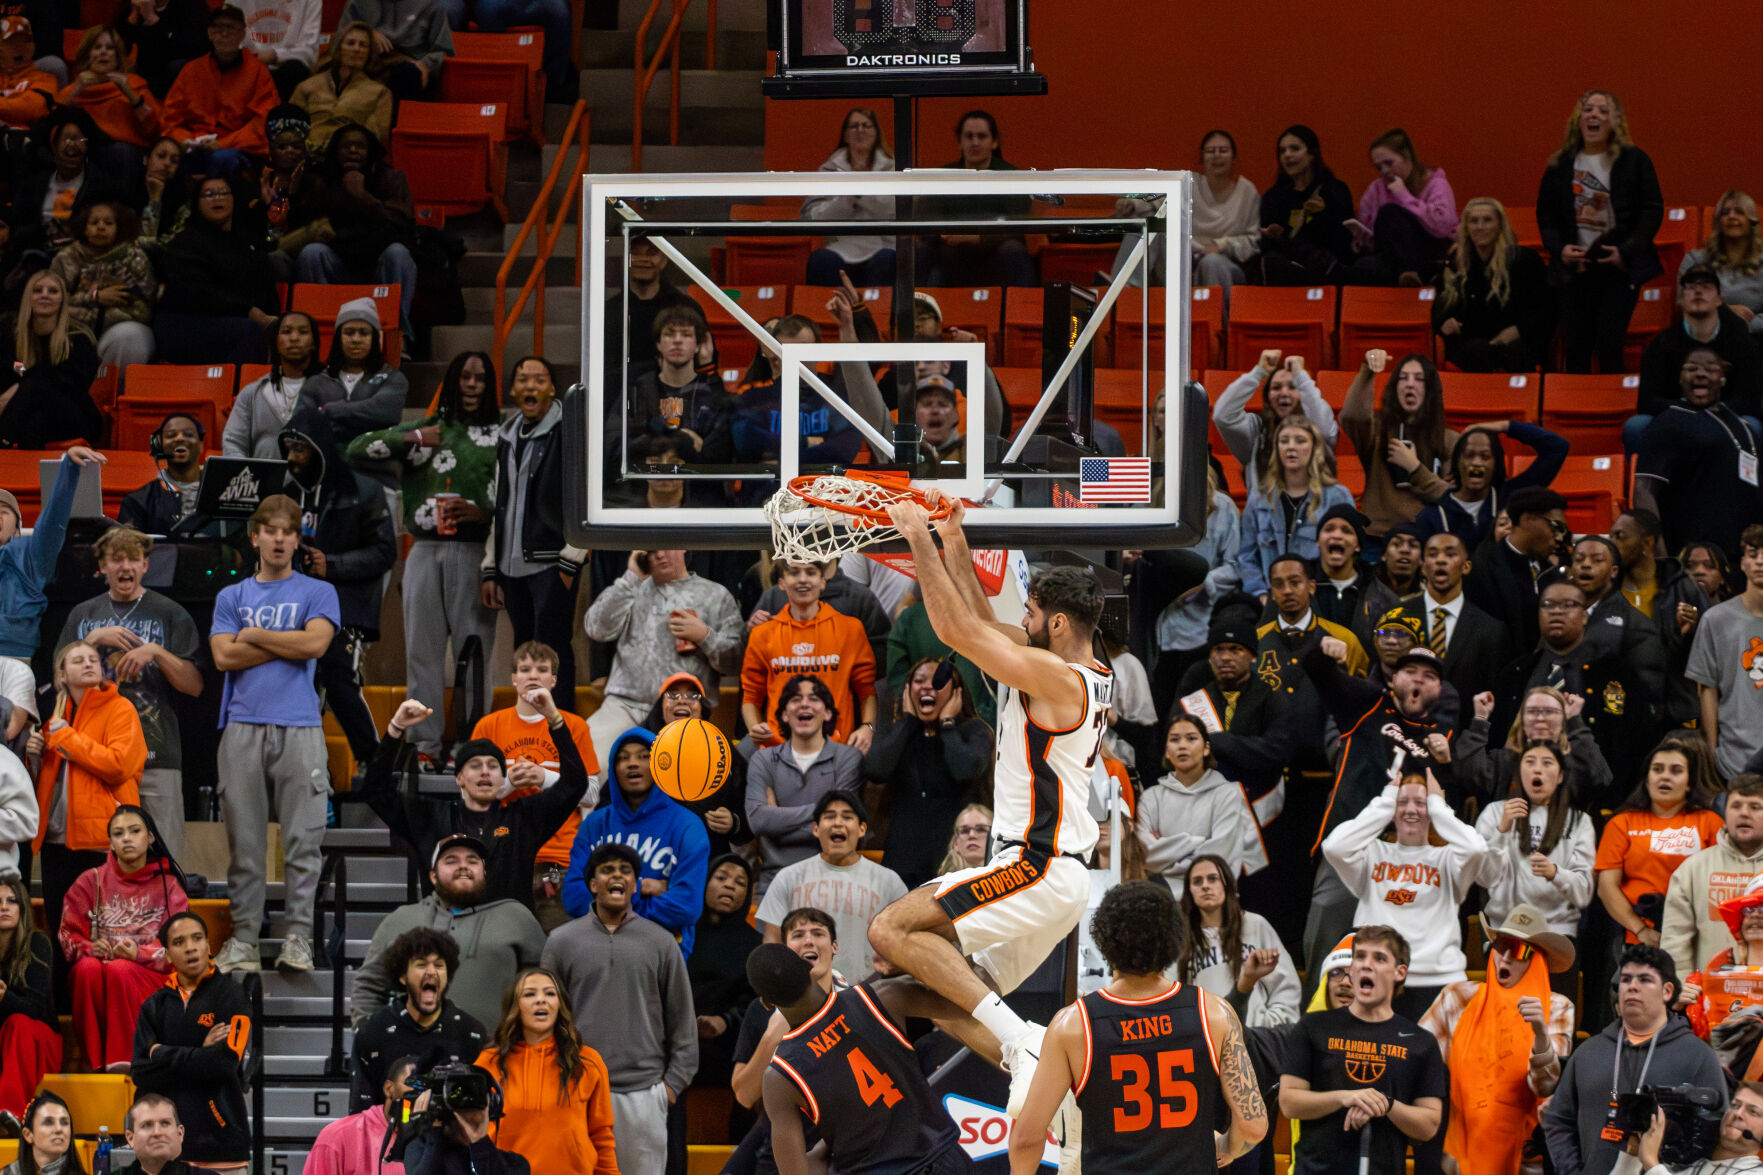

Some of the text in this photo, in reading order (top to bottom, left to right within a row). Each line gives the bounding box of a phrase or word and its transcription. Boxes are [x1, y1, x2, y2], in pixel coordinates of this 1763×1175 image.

[846, 53, 961, 66] DAKTRONICS
[771, 654, 840, 675] COWBOYS
[709, 735, 727, 790] Wilson
[970, 860, 1038, 902] COWBOYS
[1371, 861, 1441, 888] COWBOYS
[806, 1013, 851, 1059] NATT
[1120, 1014, 1173, 1041] KING
[1328, 1037, 1408, 1060] OKLAHOMA STATE
[1345, 1051, 1387, 1062] BASKETBALL
[846, 1046, 904, 1109] 4
[1110, 1048, 1198, 1133] 35
[314, 1088, 330, 1116] 6
[271, 1154, 288, 1175] 5
